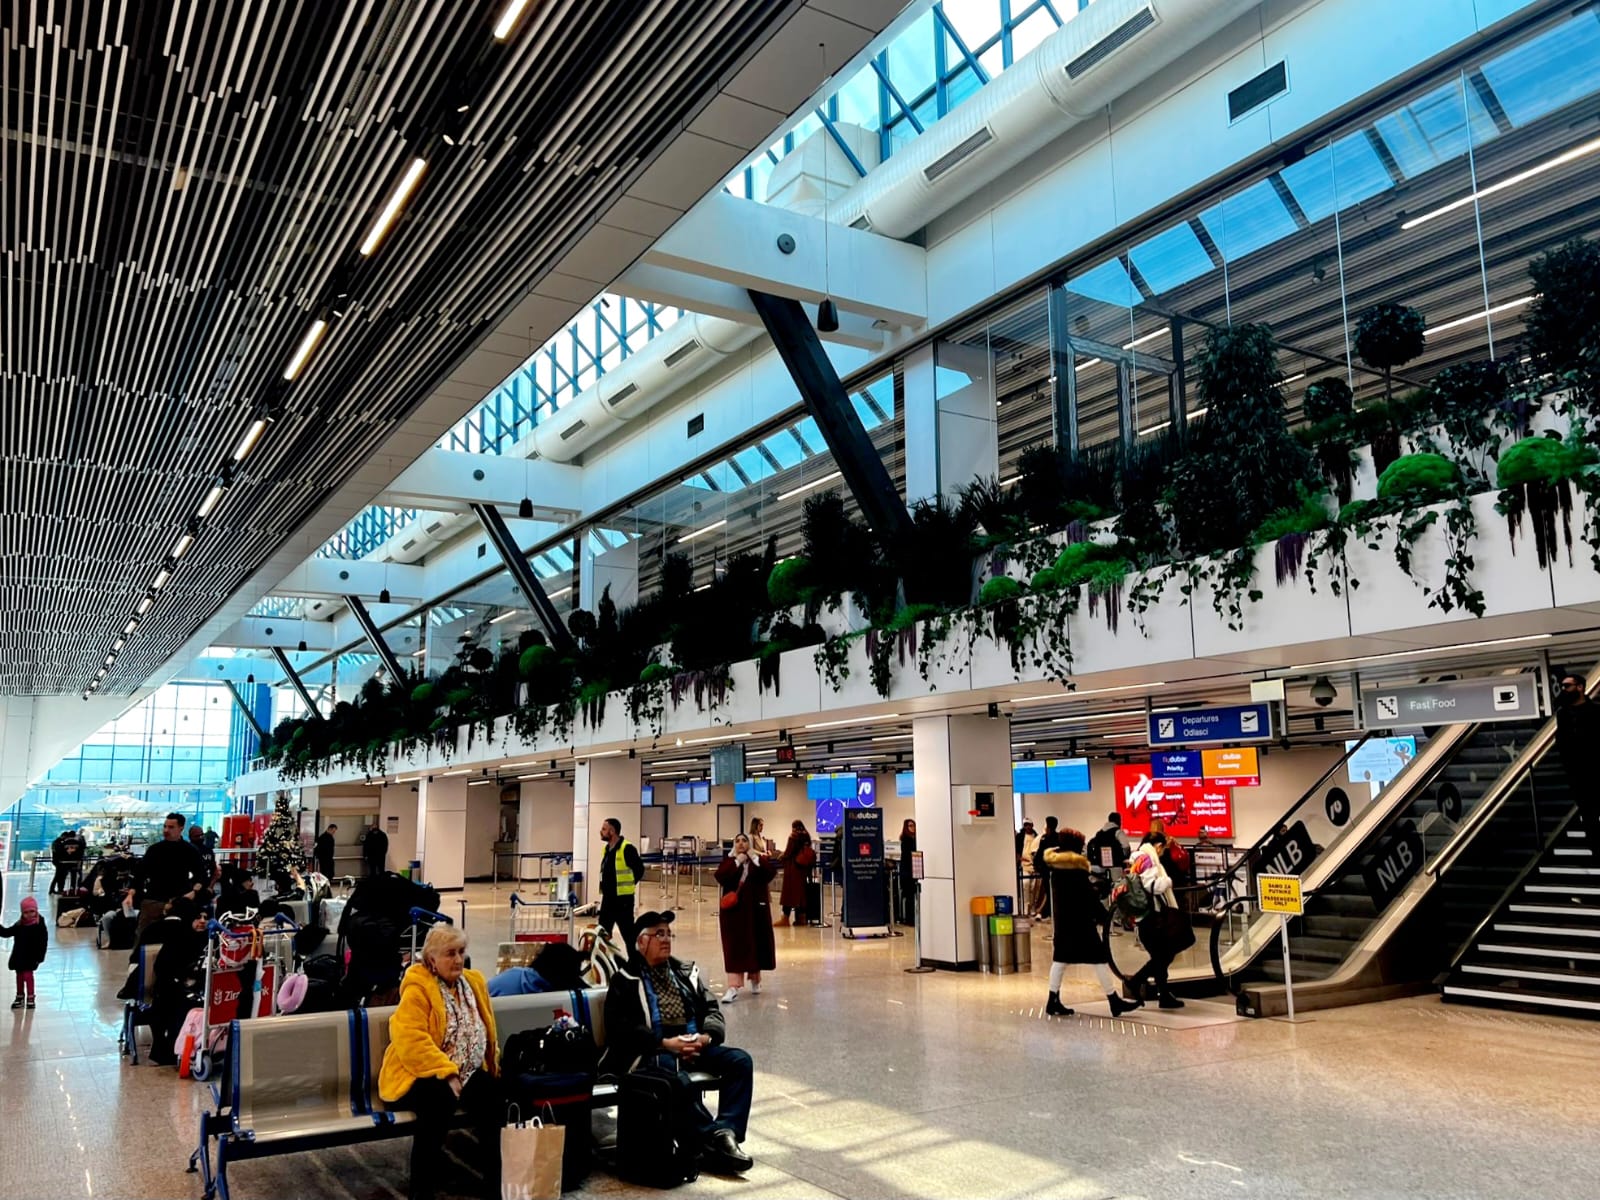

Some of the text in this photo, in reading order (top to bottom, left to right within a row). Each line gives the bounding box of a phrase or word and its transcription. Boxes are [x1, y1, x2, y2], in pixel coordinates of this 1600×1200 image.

[1409, 698, 1456, 710] Fast Food
[1182, 712, 1219, 726] Departures
[1265, 840, 1304, 875] NLB
[1376, 841, 1413, 892] NLB
